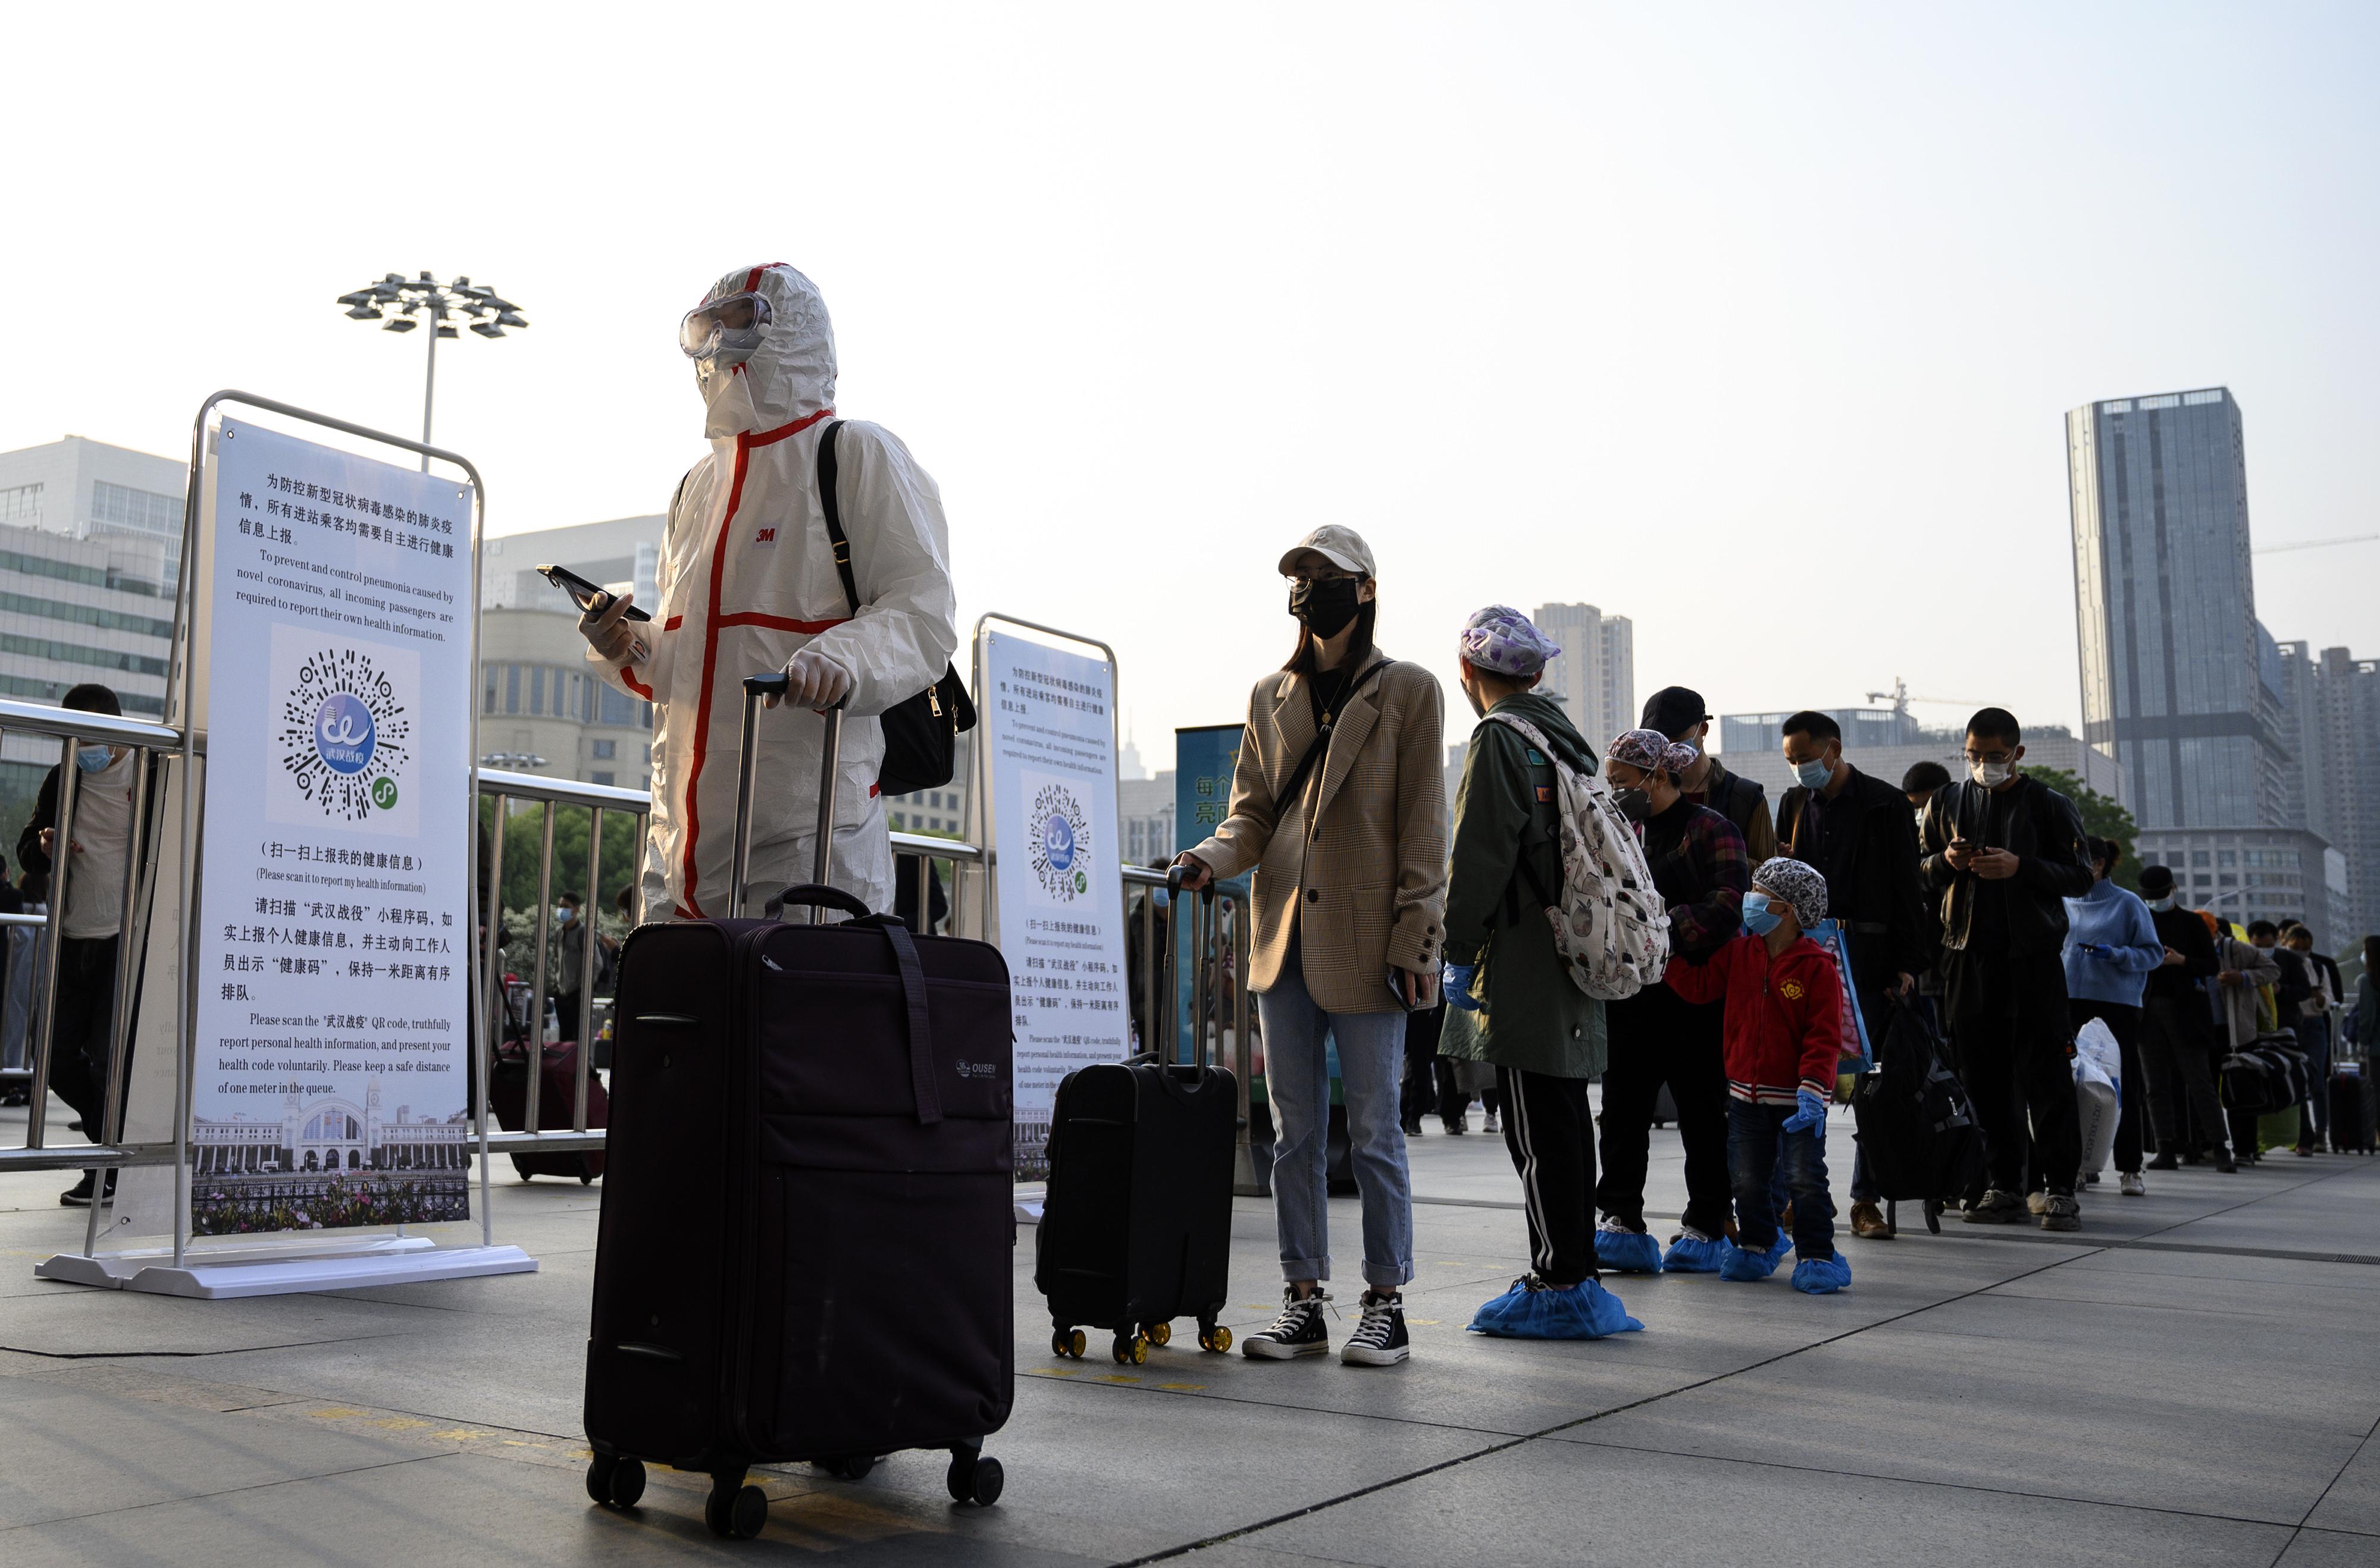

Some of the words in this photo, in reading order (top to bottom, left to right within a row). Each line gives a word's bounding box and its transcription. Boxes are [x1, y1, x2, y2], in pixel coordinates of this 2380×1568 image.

[756, 528, 775, 542] 3M
[260, 548, 273, 562] To
[274, 555, 310, 571] prevent
[311, 564, 328, 575] and
[330, 568, 362, 583] control
[364, 575, 411, 594] pneumonia
[412, 587, 441, 600] caused
[443, 591, 454, 605] by
[237, 569, 263, 582] novel
[267, 576, 325, 598] coronavirus,
[330, 587, 341, 600] all
[345, 590, 386, 611] incoming
[389, 603, 436, 620] passengers
[440, 613, 453, 623] are
[236, 591, 276, 607] required
[278, 598, 288, 610] to
[290, 602, 318, 616] report
[320, 607, 343, 621] their
[343, 614, 362, 625] own
[364, 615, 391, 631] health
[393, 622, 446, 642] information.
[256, 867, 285, 881] (Please
[286, 873, 303, 883] scan
[305, 871, 311, 883] it
[312, 874, 320, 884] to
[321, 876, 343, 888] report
[344, 878, 355, 889] my
[356, 876, 379, 889] health
[380, 879, 426, 895] information)
[250, 1012, 280, 1026] Please
[282, 1017, 303, 1026] scan
[305, 1015, 320, 1027] the
[372, 1017, 385, 1030] QR
[387, 1017, 410, 1031] code,
[412, 1018, 451, 1032] truthfully
[220, 1037, 249, 1050] report
[251, 1037, 292, 1050] personal
[294, 1037, 322, 1049] health
[324, 1038, 379, 1052] information,
[381, 1040, 397, 1050] and
[399, 1041, 430, 1053] present
[432, 1043, 451, 1053] your
[218, 1058, 249, 1071] health
[252, 1059, 275, 1071] code
[277, 1059, 330, 1073] voluntarily.
[333, 1059, 362, 1071] Please
[365, 1060, 386, 1074] keep
[388, 1063, 393, 1071] a
[396, 1061, 414, 1072] safe
[416, 1061, 450, 1072] distance
[218, 1081, 229, 1094] of
[230, 1084, 248, 1094] one
[249, 1083, 277, 1094] meter
[278, 1082, 288, 1094] in
[290, 1081, 305, 1094] the
[306, 1084, 336, 1096] queue.
